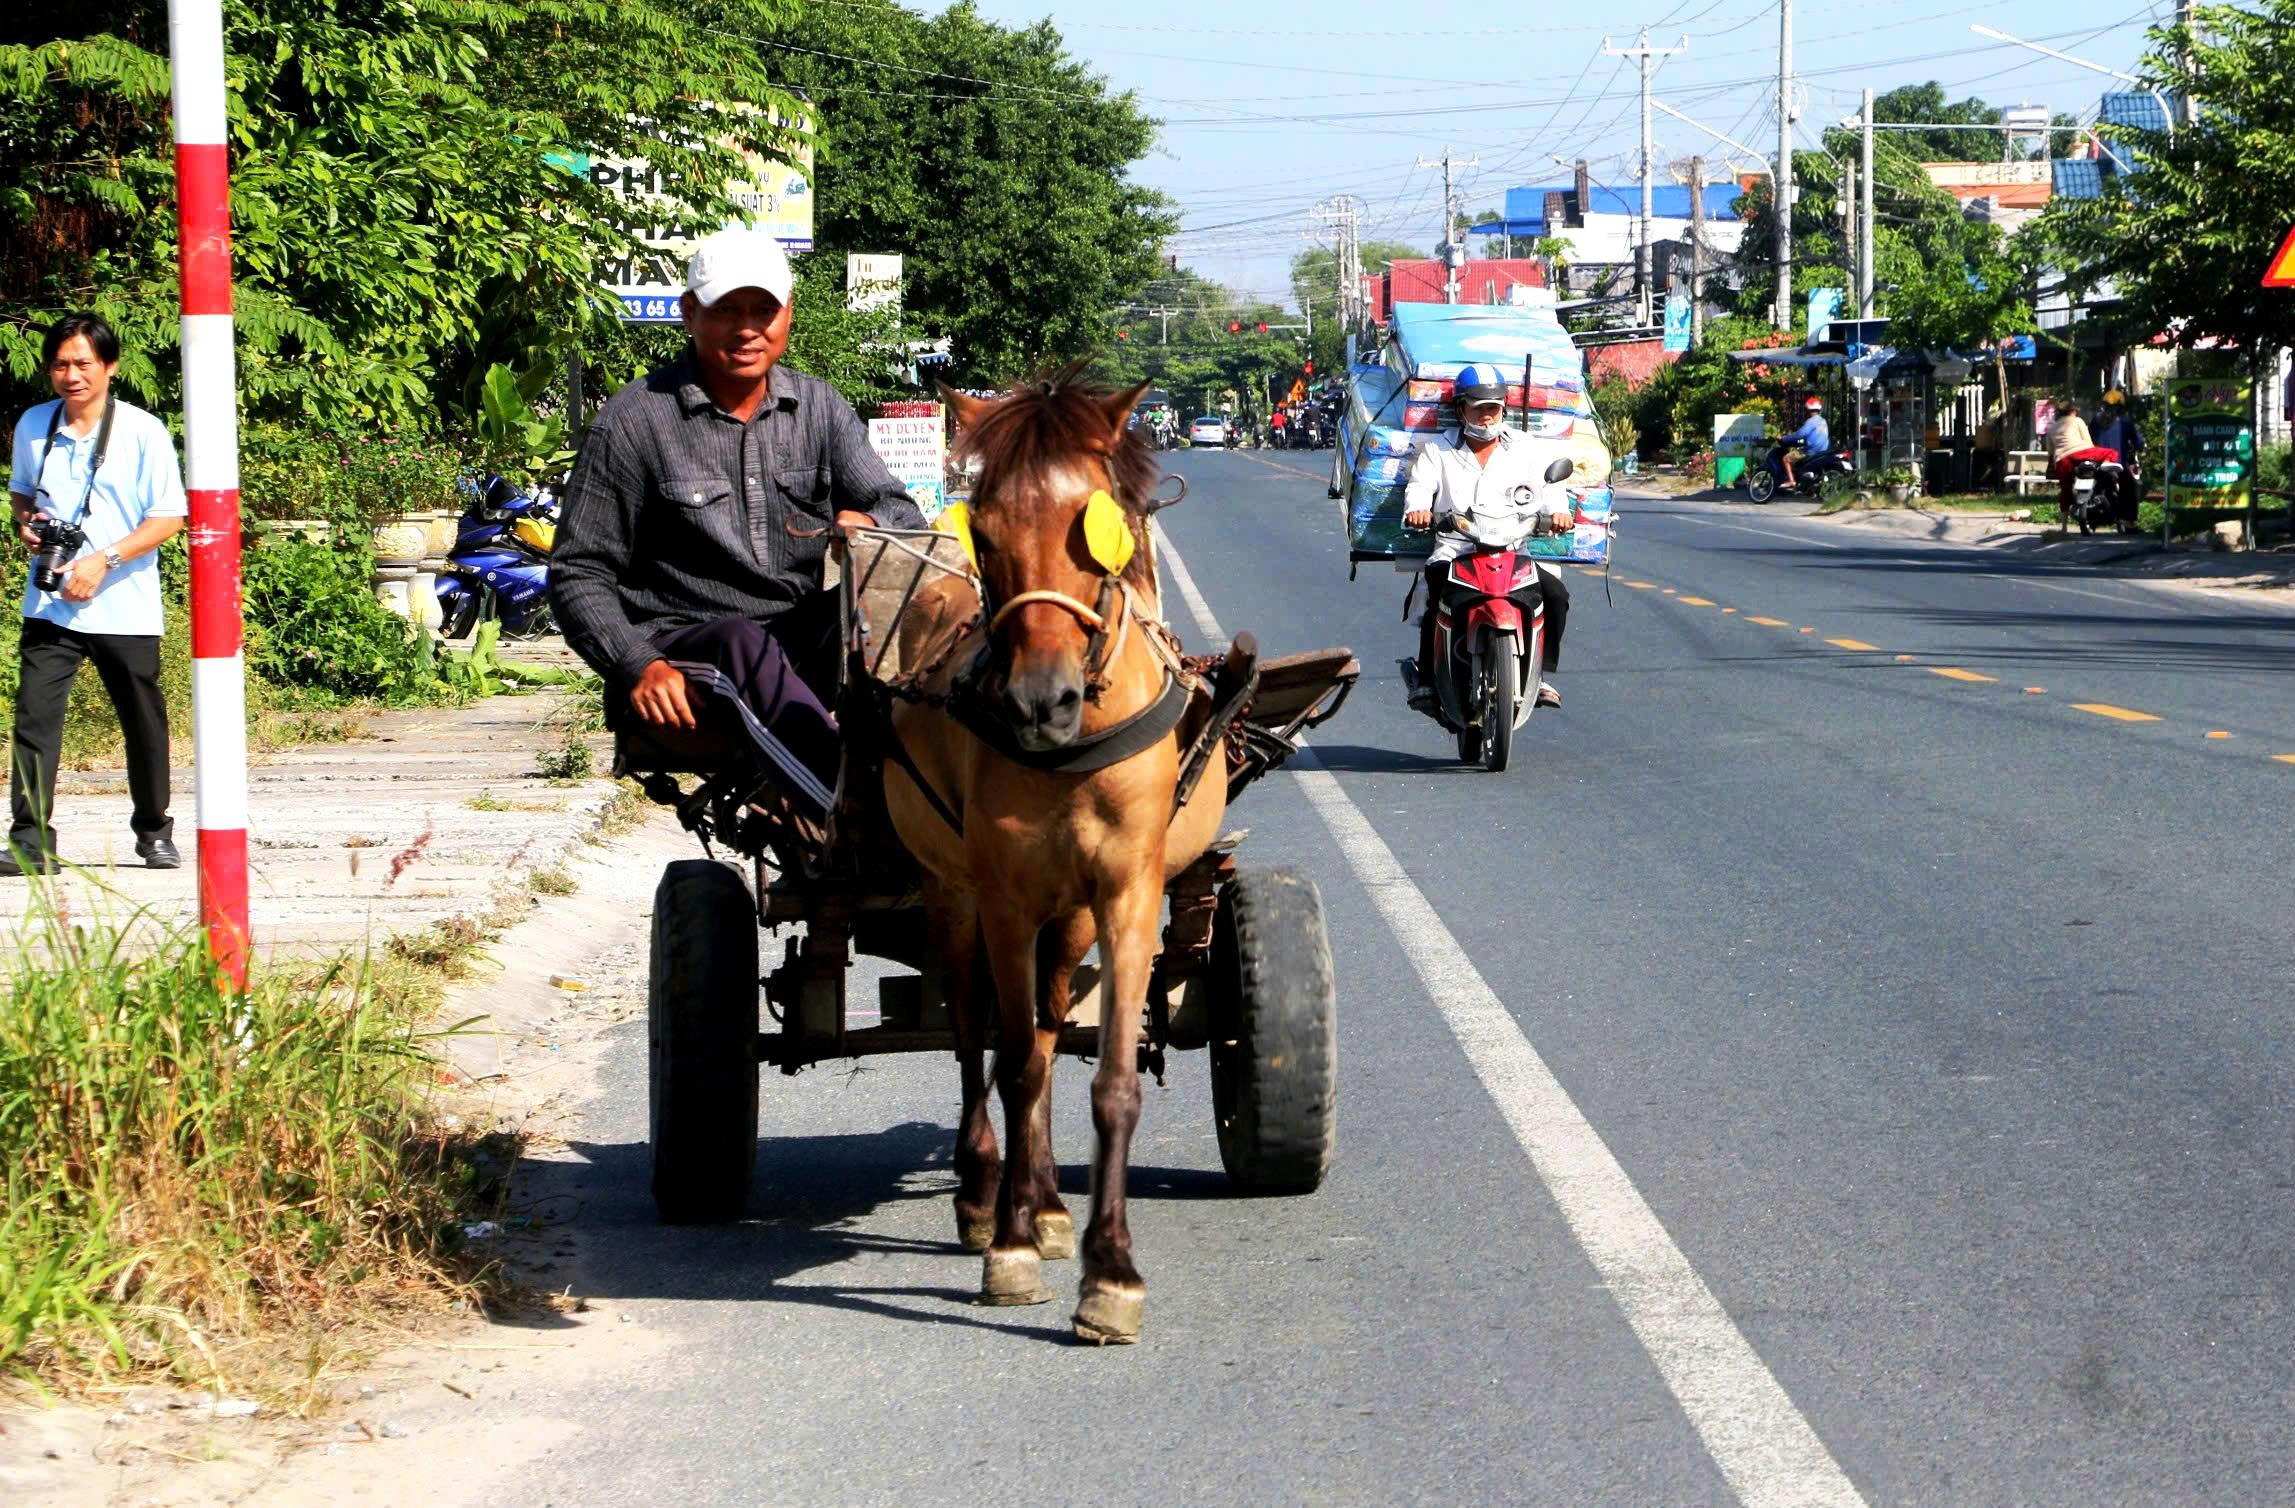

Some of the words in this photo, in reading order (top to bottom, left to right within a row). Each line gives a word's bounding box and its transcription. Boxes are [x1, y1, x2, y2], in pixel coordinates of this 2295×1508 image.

[646, 300, 666, 317] 65
[669, 300, 682, 317] 6
[512, 588, 535, 601] YAMAHA
